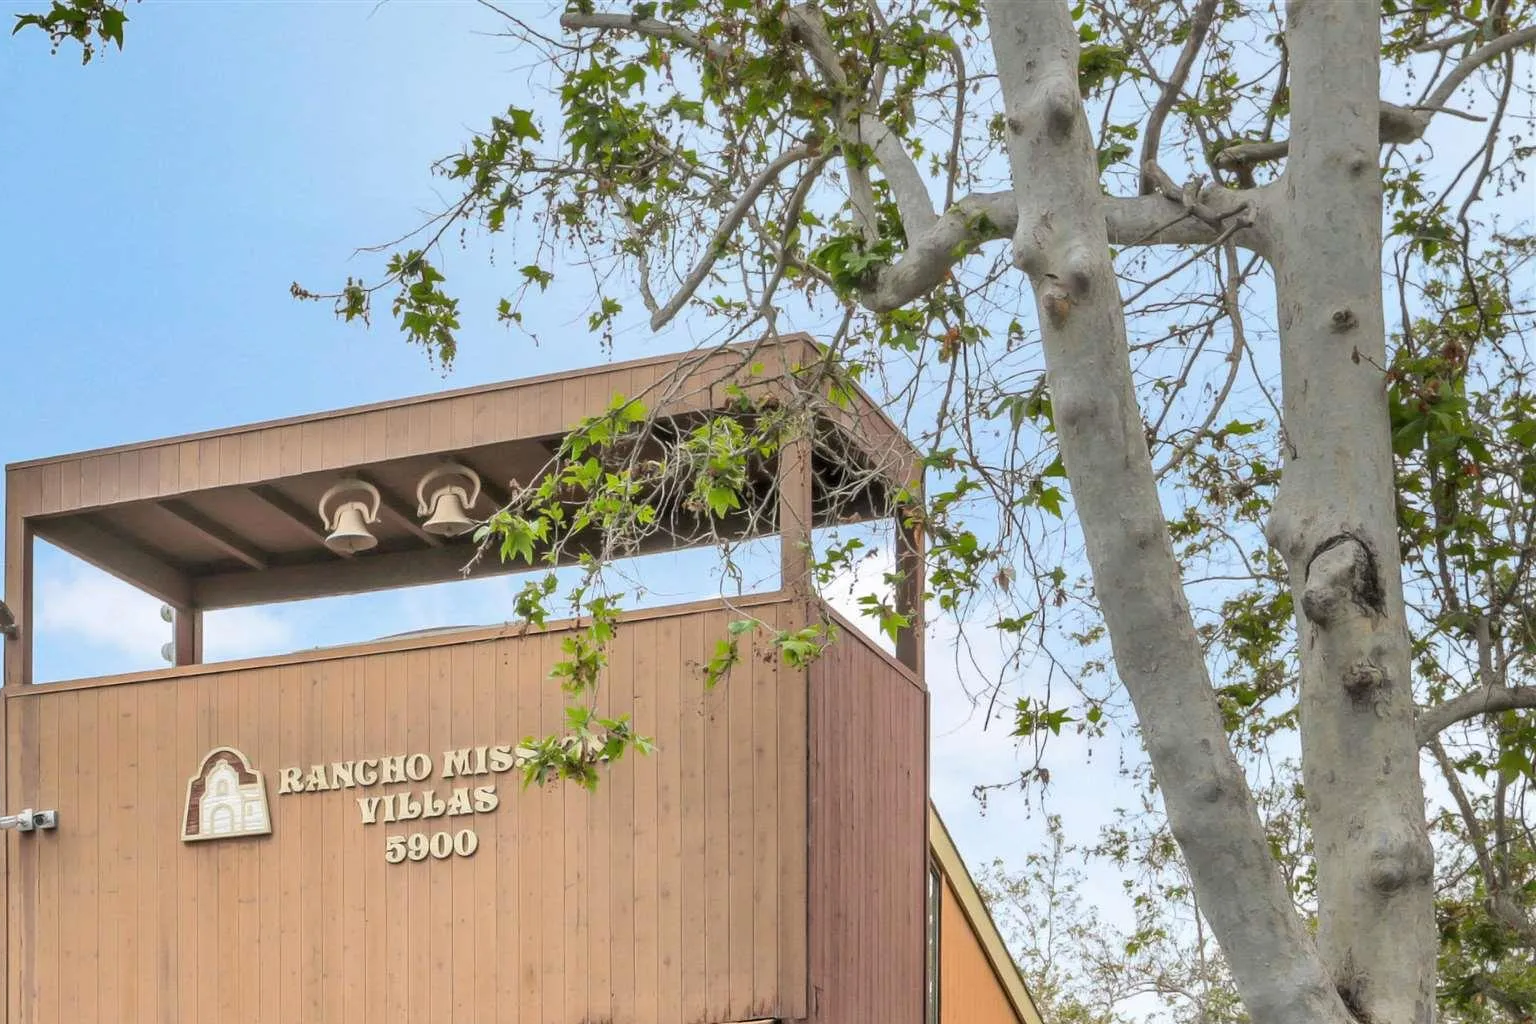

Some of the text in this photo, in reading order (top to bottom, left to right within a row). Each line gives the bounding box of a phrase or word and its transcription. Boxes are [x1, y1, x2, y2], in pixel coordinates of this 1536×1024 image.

[278, 753, 433, 795] RANCHO
[356, 785, 499, 824] VILLAS
[384, 829, 478, 864] 5900
